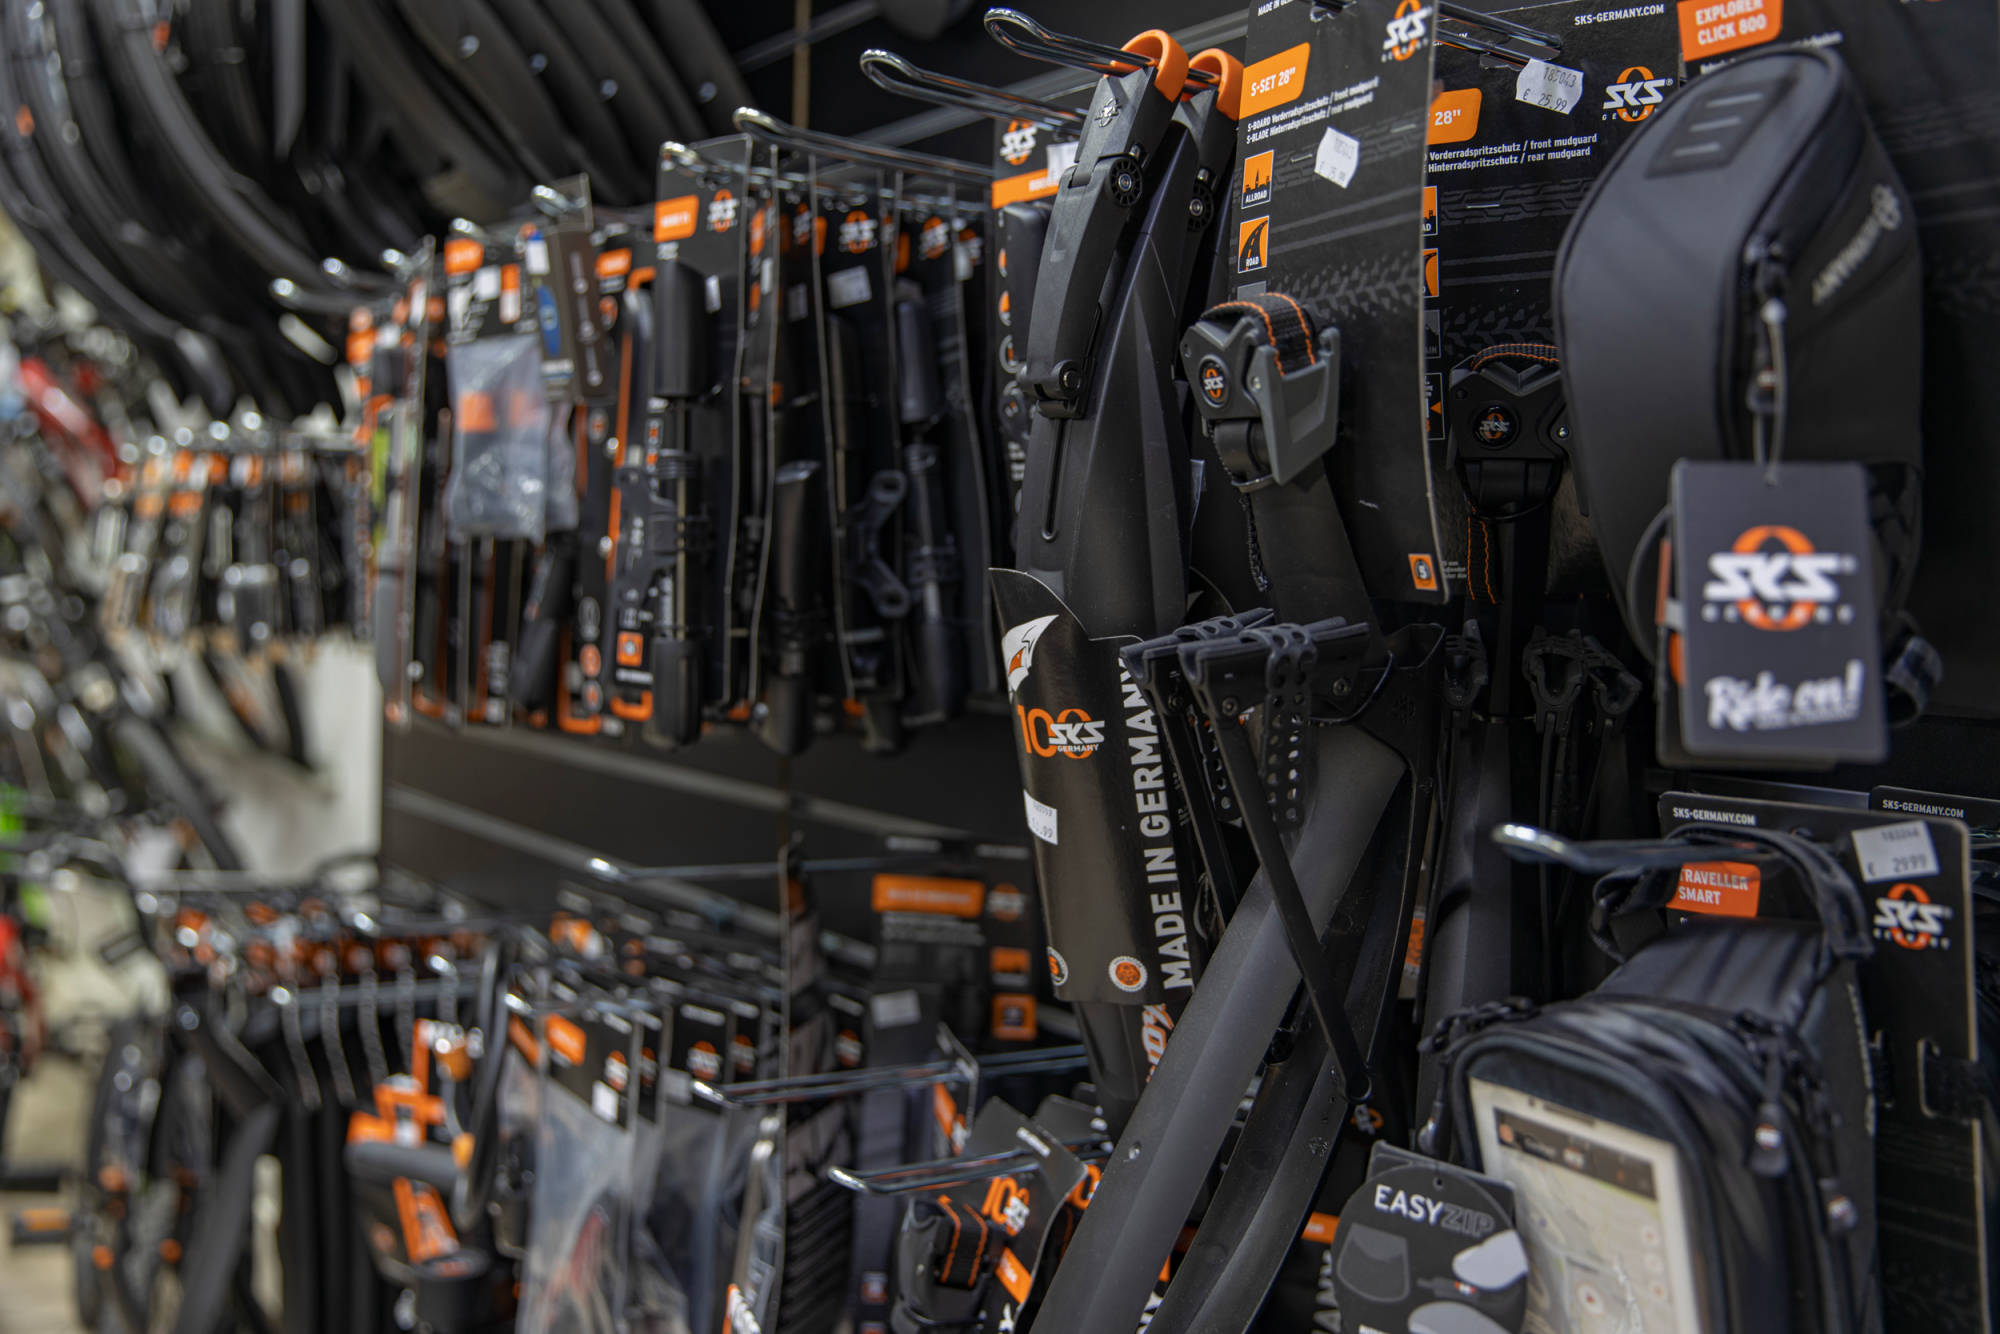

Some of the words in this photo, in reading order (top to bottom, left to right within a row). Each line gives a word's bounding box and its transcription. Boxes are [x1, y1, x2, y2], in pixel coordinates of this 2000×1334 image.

[1574, 4, 1664, 25] SKS-GERMANY.COM
[1696, 0, 1763, 25] EXPLORER
[1698, 22, 1735, 45] CLICK
[1739, 14, 1767, 35] 800
[1251, 74, 1275, 97] S-SET
[1602, 109, 1658, 121] GERMA
[1430, 143, 1520, 161] Vorderradspritzschutz
[1523, 140, 1528, 151] /
[1530, 139, 1551, 150] front
[1554, 133, 1597, 148] mudguard
[1428, 156, 1518, 173] Hinterradspritzschutz
[1520, 153, 1525, 164] /
[1528, 152, 1545, 162] rear
[1548, 147, 1590, 161] mudguard
[1245, 190, 1267, 203] ALLROAD
[1246, 256, 1259, 267] ROAD
[1049, 720, 1105, 745] SKS
[1057, 743, 1099, 753] GERMANY
[1673, 806, 1756, 826] SKS-GERMANY.COM
[1882, 799, 1964, 819] SKS-GERMANY.COM
[1144, 847, 1178, 884] IN
[1679, 868, 1749, 892] TRAVELLER
[1679, 886, 1721, 905] SMART
[1151, 892, 1195, 990] MADE
